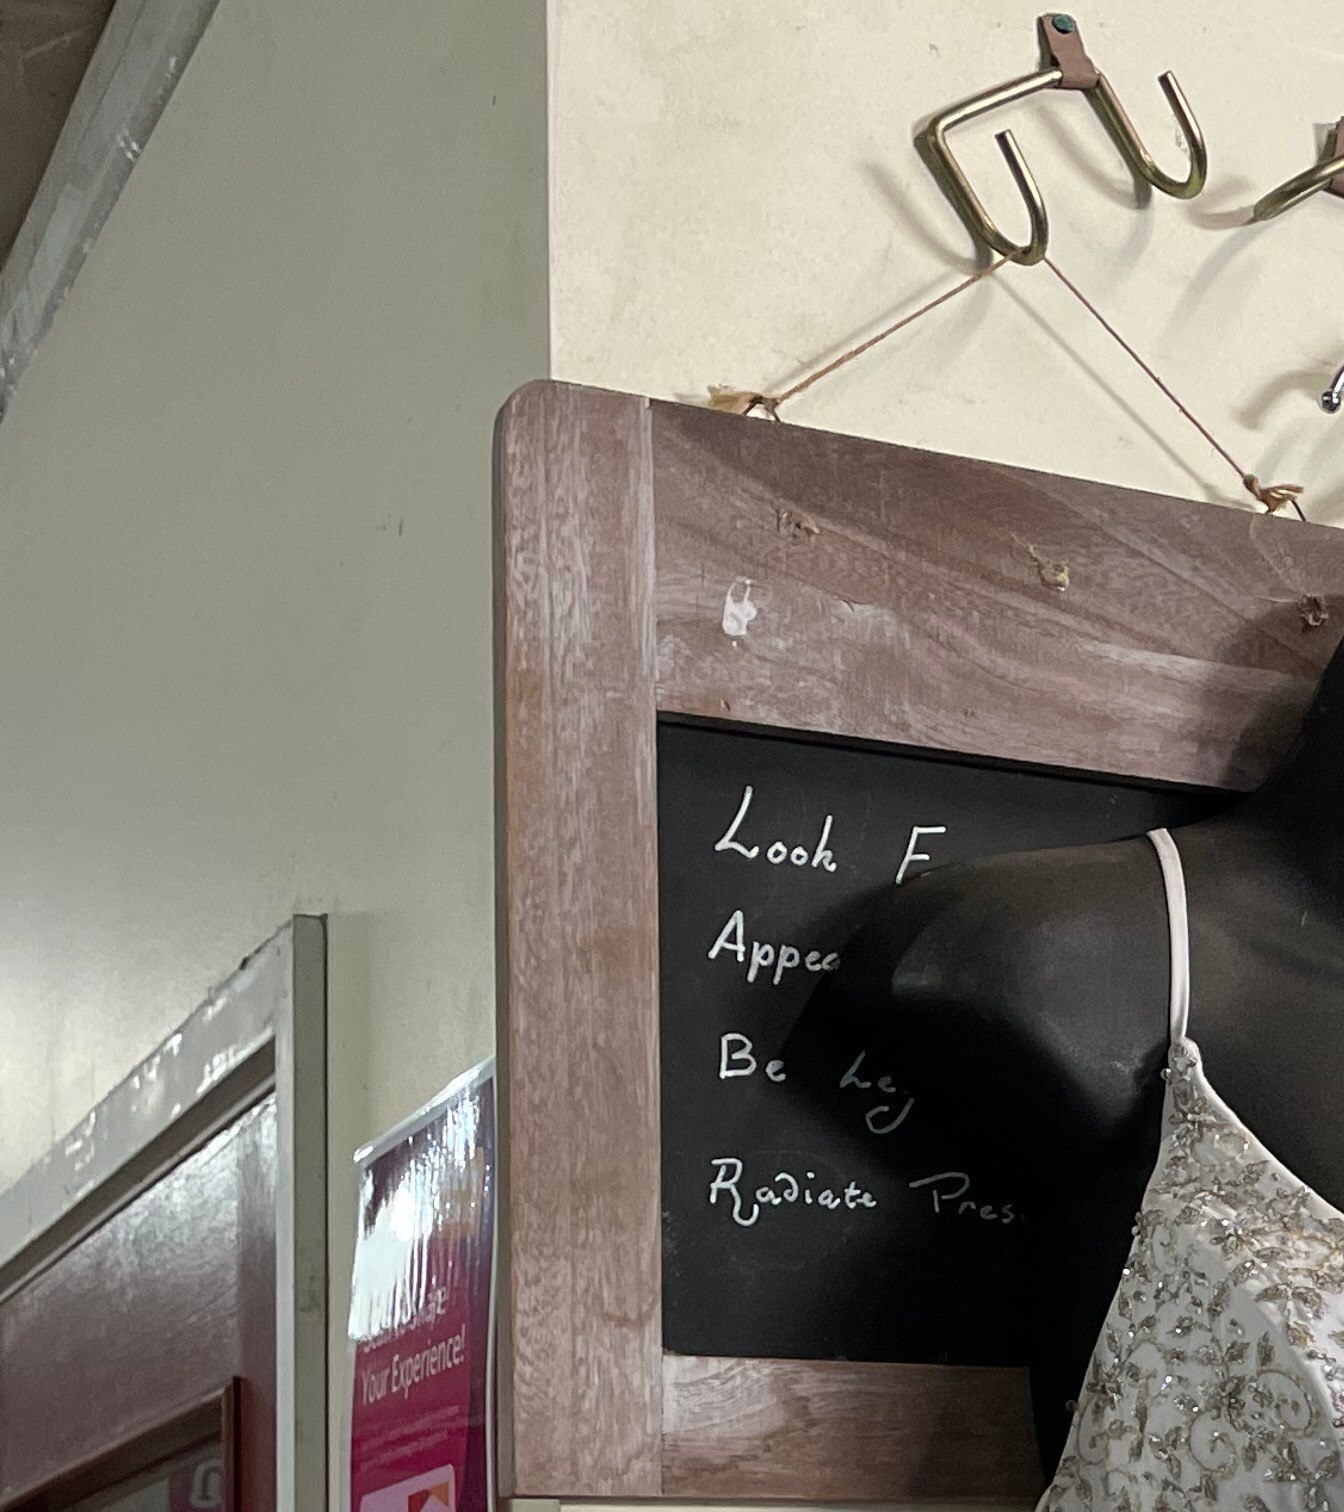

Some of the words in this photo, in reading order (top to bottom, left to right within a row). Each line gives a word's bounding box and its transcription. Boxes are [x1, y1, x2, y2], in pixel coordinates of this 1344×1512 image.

[715, 785, 837, 872] Look
[719, 1033, 788, 1082] Be
[708, 1157, 877, 1227] Radiate
[361, 1360, 389, 1406] Your
[390, 1324, 466, 1398] Experience!
